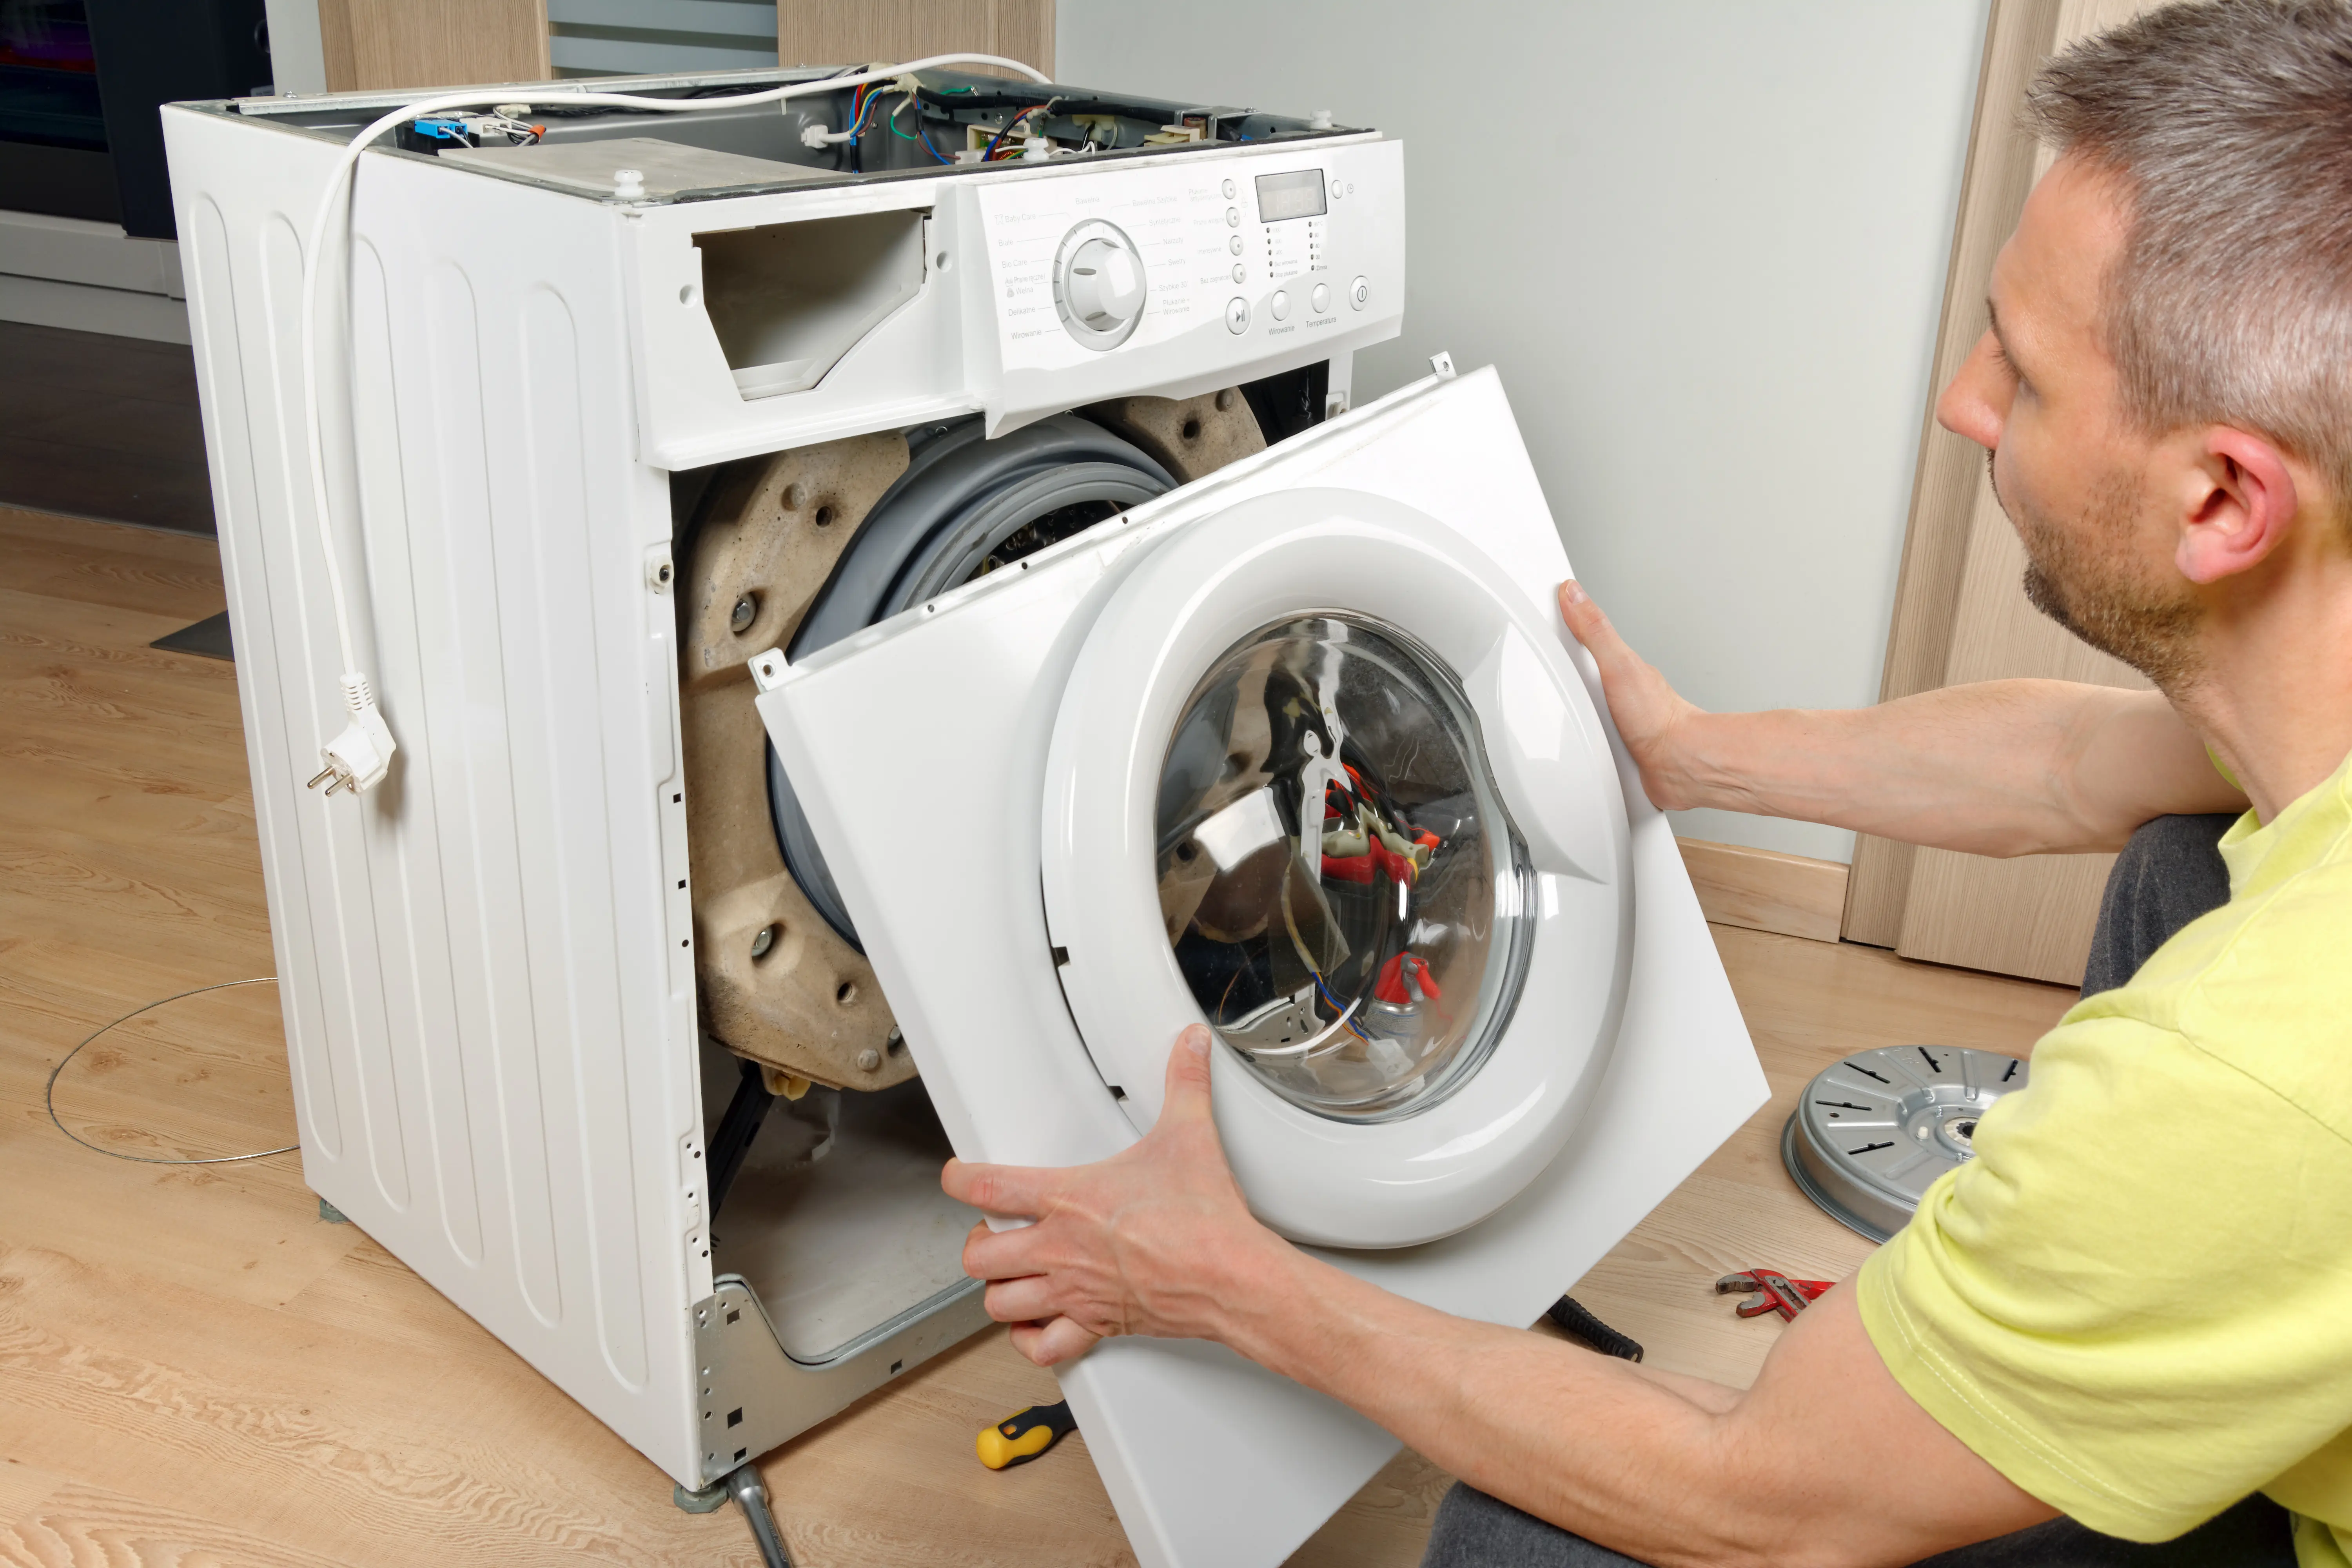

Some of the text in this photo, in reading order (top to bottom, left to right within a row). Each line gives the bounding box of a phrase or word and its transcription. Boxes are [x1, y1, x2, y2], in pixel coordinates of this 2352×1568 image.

[1149, 217, 1181, 227] Syntetyczne
[1163, 237, 1183, 245] Narzuty
[1159, 283, 1179, 292] Szybkie
[1008, 307, 1036, 316] Delikatne
[1163, 307, 1190, 315] Wirowanie
[1306, 317, 1337, 328] Temperatura
[1011, 328, 1042, 340] Wirowanie
[1269, 324, 1295, 336] Wirowanie
